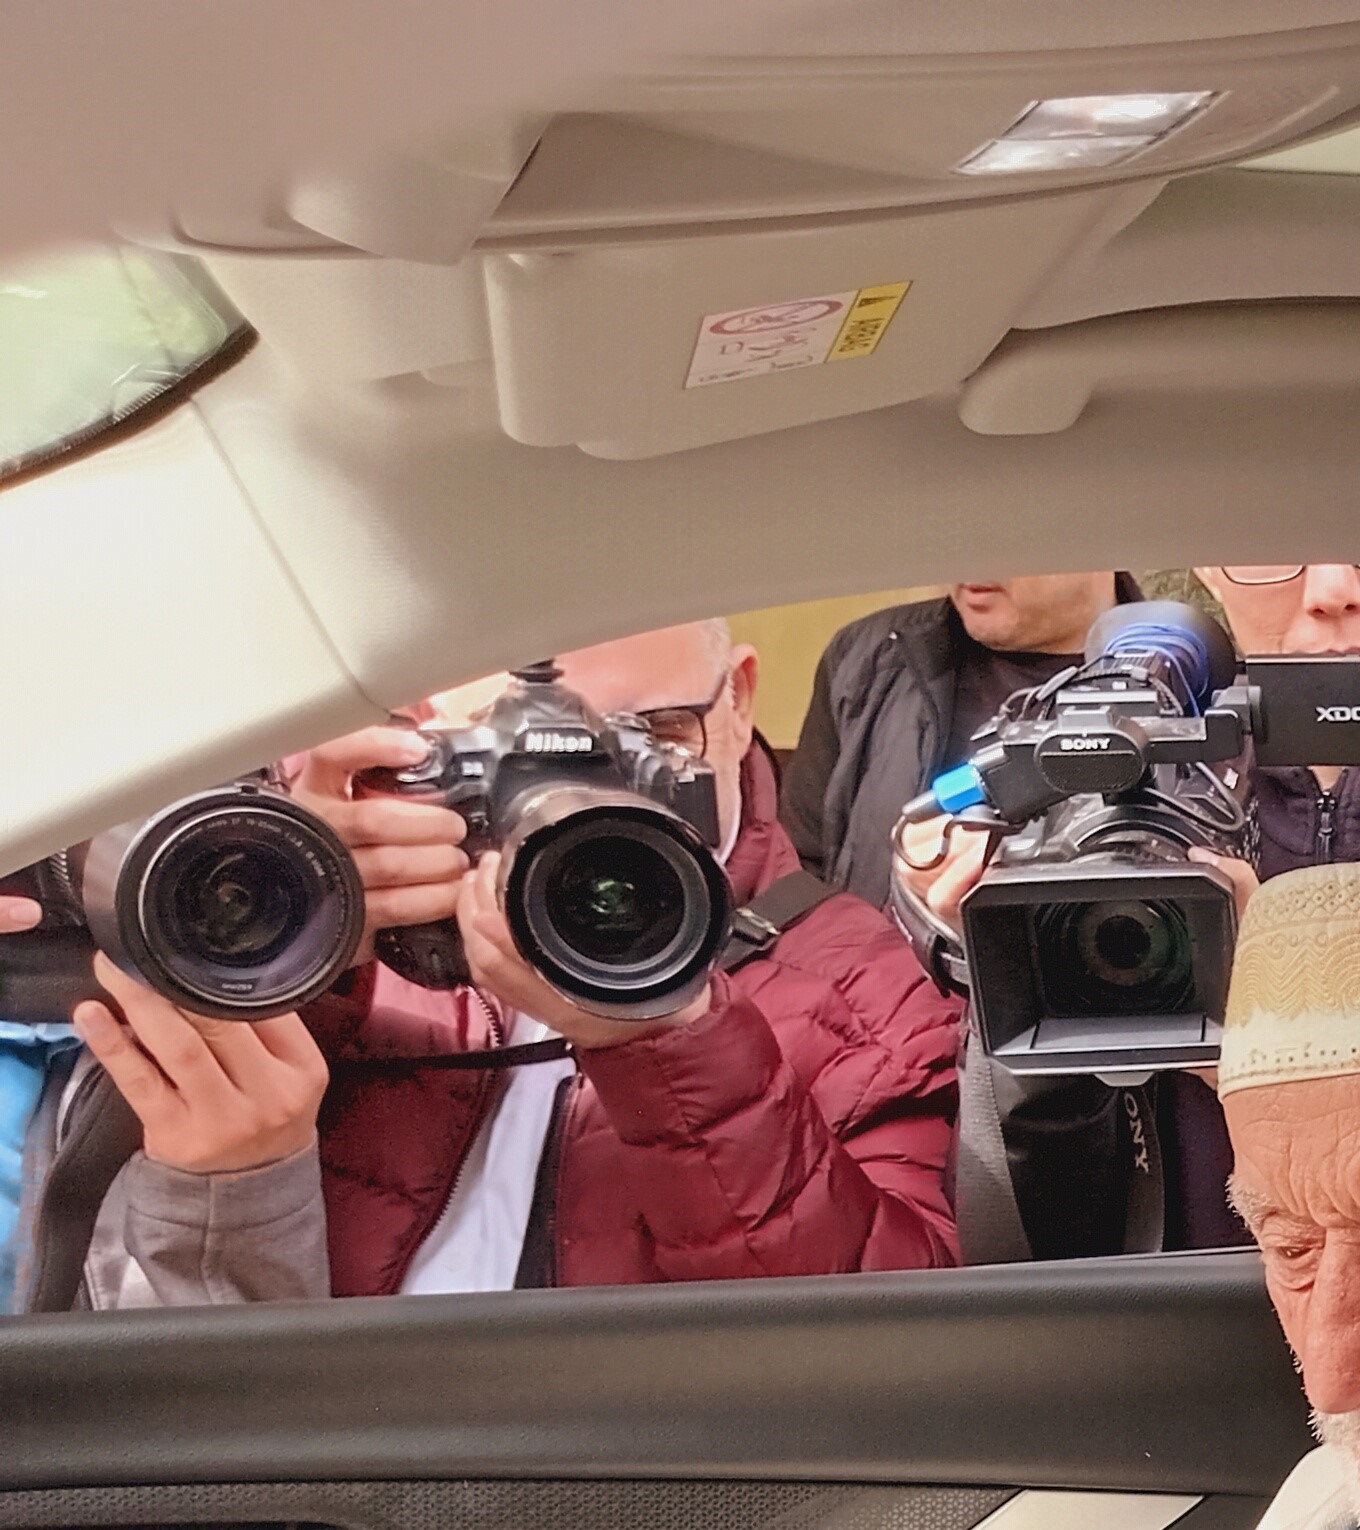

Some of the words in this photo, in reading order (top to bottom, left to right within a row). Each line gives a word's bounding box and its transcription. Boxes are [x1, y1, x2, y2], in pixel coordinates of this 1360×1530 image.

[525, 732, 593, 752] Nikon
[1060, 738, 1111, 751] SONY
[1123, 1092, 1150, 1174] ONY
